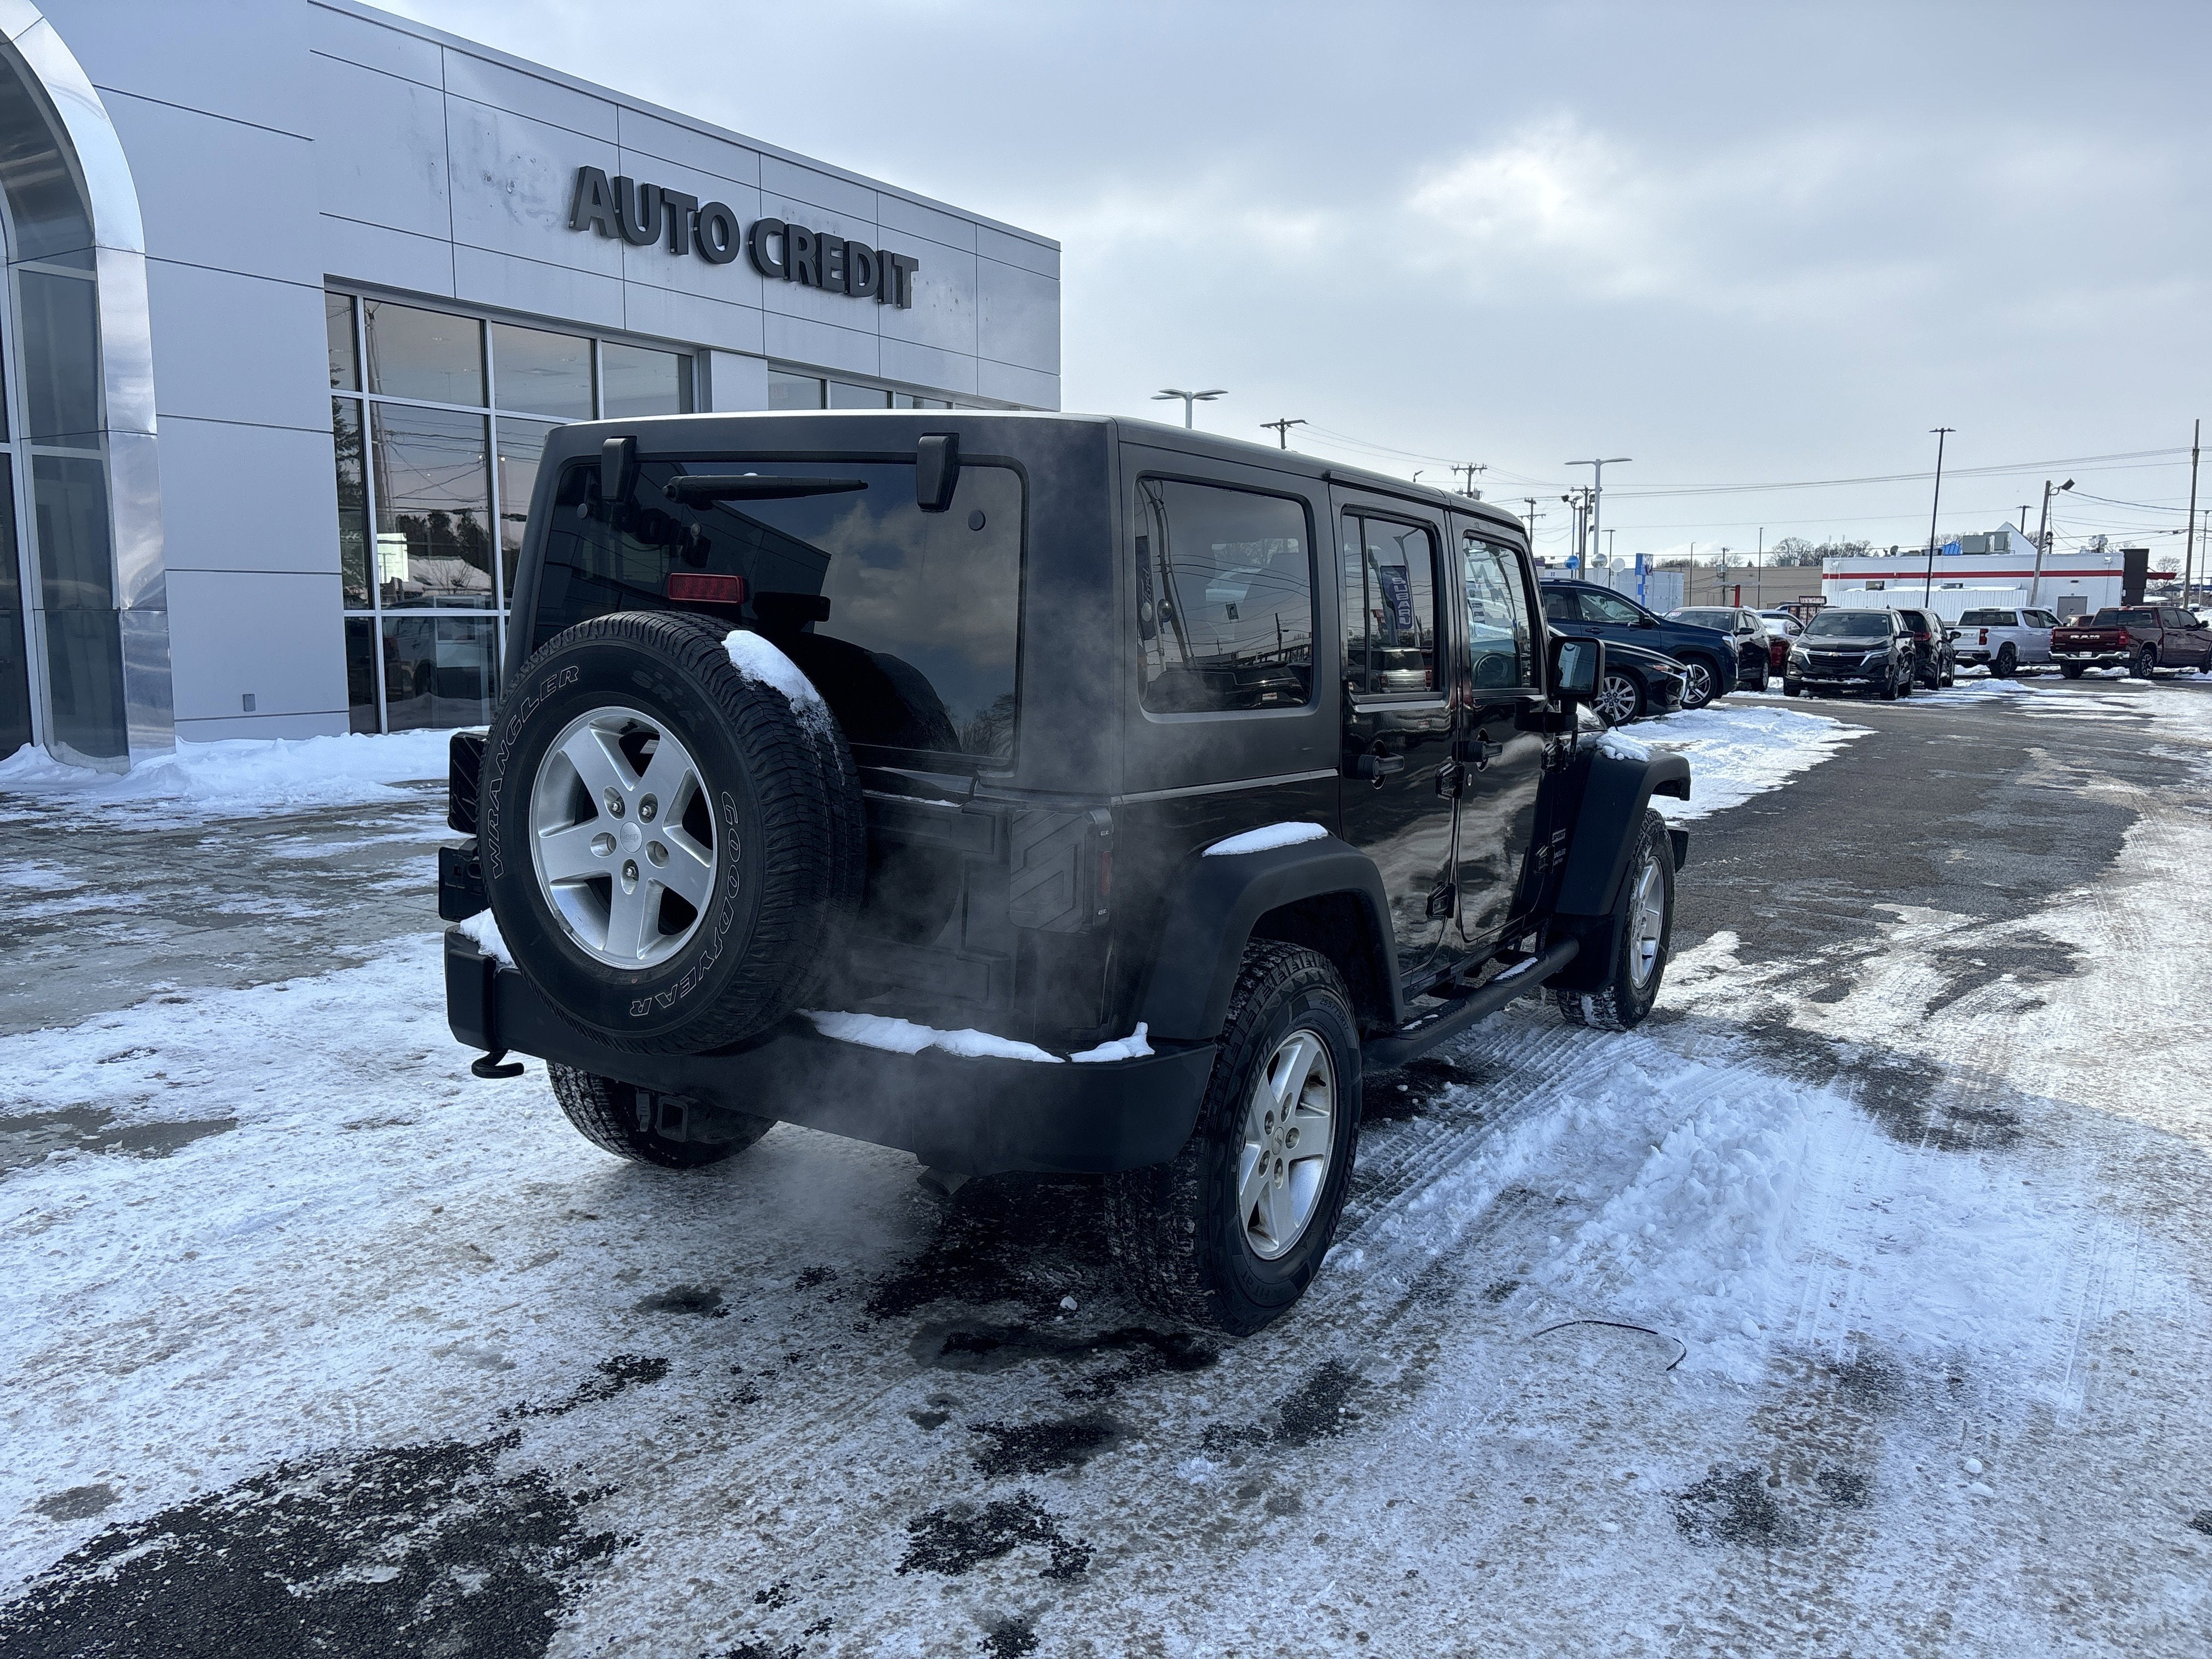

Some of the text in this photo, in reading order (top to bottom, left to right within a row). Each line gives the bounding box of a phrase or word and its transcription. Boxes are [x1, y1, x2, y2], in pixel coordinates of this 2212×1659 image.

[569, 166, 919, 309] AUTO CREDIT
[1391, 577, 1411, 624] SUBARU
[488, 665, 579, 879] WRANGLER
[629, 791, 741, 1017] GOODYEAR
[1319, 998, 1349, 1030] 255/75R17
